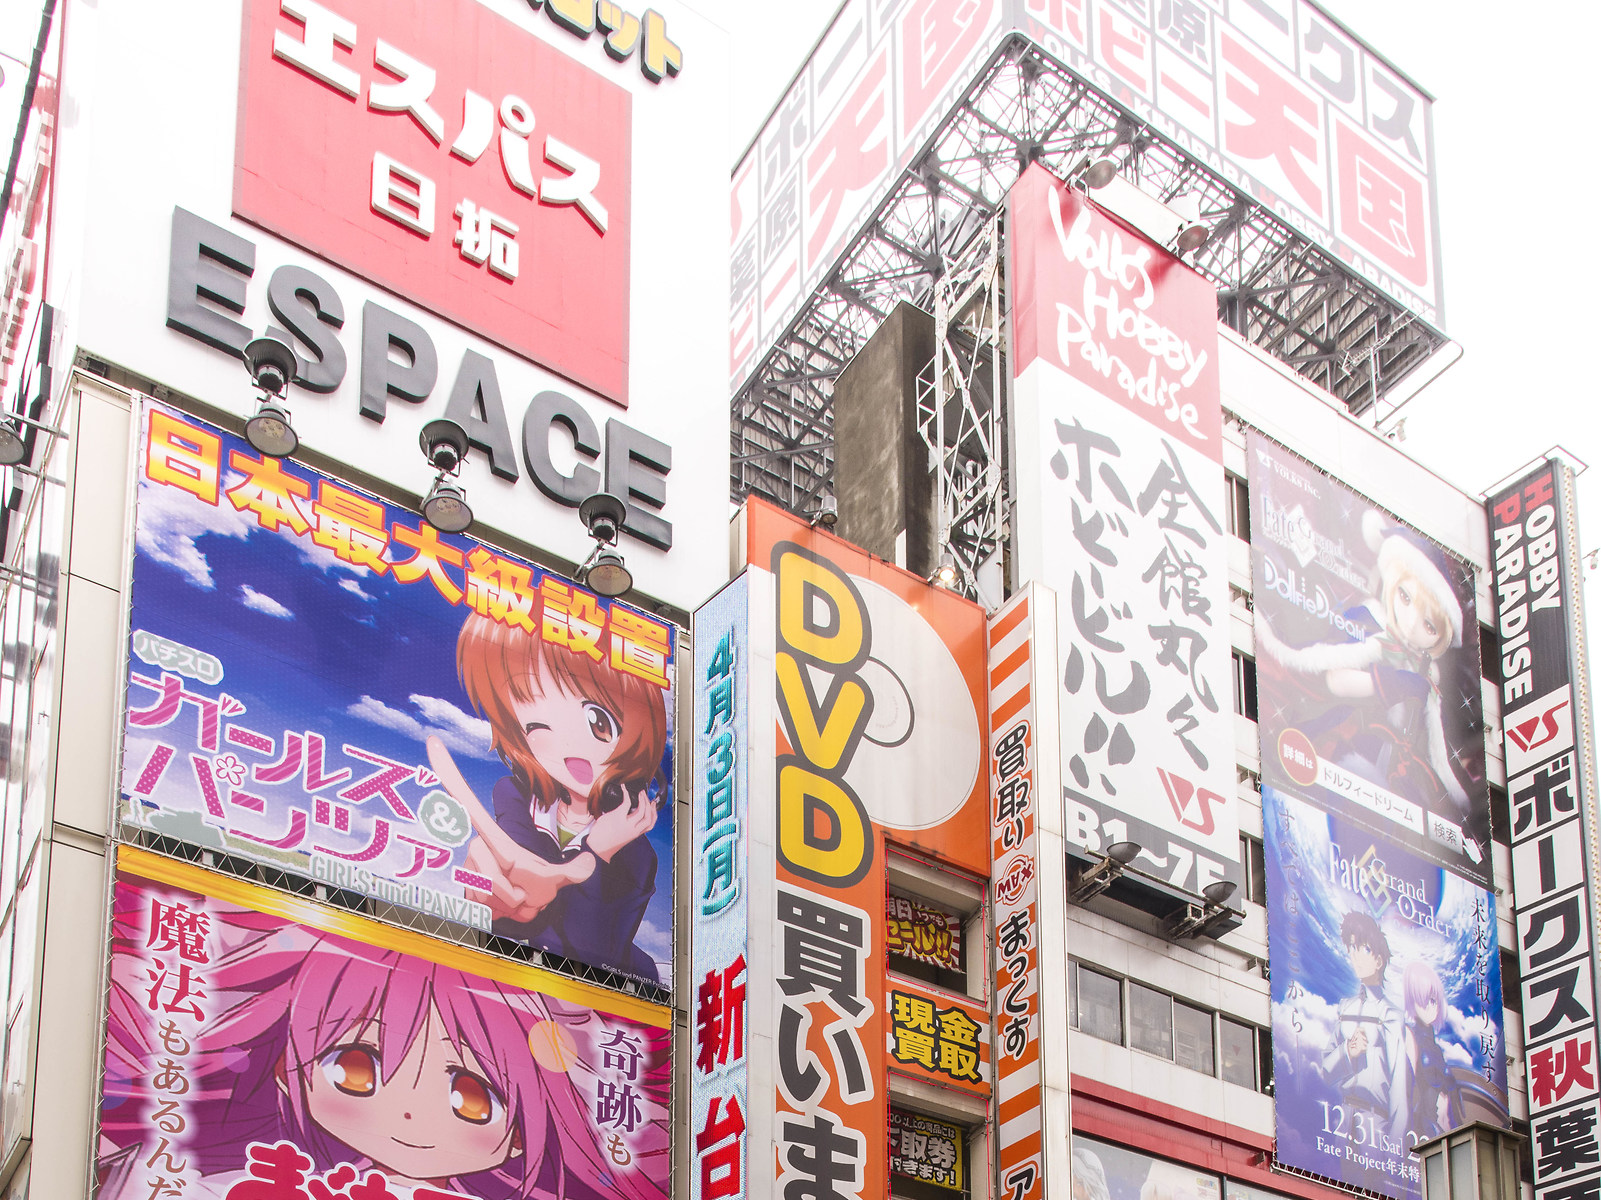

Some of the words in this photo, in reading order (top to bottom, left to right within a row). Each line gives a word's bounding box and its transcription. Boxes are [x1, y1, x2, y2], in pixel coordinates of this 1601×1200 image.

[273, 0, 608, 236] エスパス
[369, 151, 520, 281] 日拓
[165, 205, 672, 552] ESPACE
[1056, 302, 1209, 440] Paradise
[145, 407, 673, 691] 日本最大級設置
[1493, 497, 1533, 706] PARADISE
[1525, 471, 1561, 610] HOBBY
[136, 634, 219, 683] パチスロ
[771, 540, 875, 889] DVD
[995, 724, 1029, 851] 買取り
[1282, 742, 1315, 770] 詳細は
[1323, 766, 1415, 824] ドルフィードリーム
[311, 852, 372, 896] GIRLS
[414, 884, 494, 932] PANZER
[1329, 841, 1370, 899] Fate
[1433, 820, 1458, 847] 検索
[998, 908, 1031, 1060] まっくす
[1278, 807, 1304, 1034] すべてはここから
[894, 991, 978, 1047] 現金
[894, 1024, 982, 1082] 買取
[1469, 897, 1497, 1086] 未来を取り戻す
[595, 1027, 645, 1168] 奇跡も
[1316, 1136, 1342, 1158] Fate
